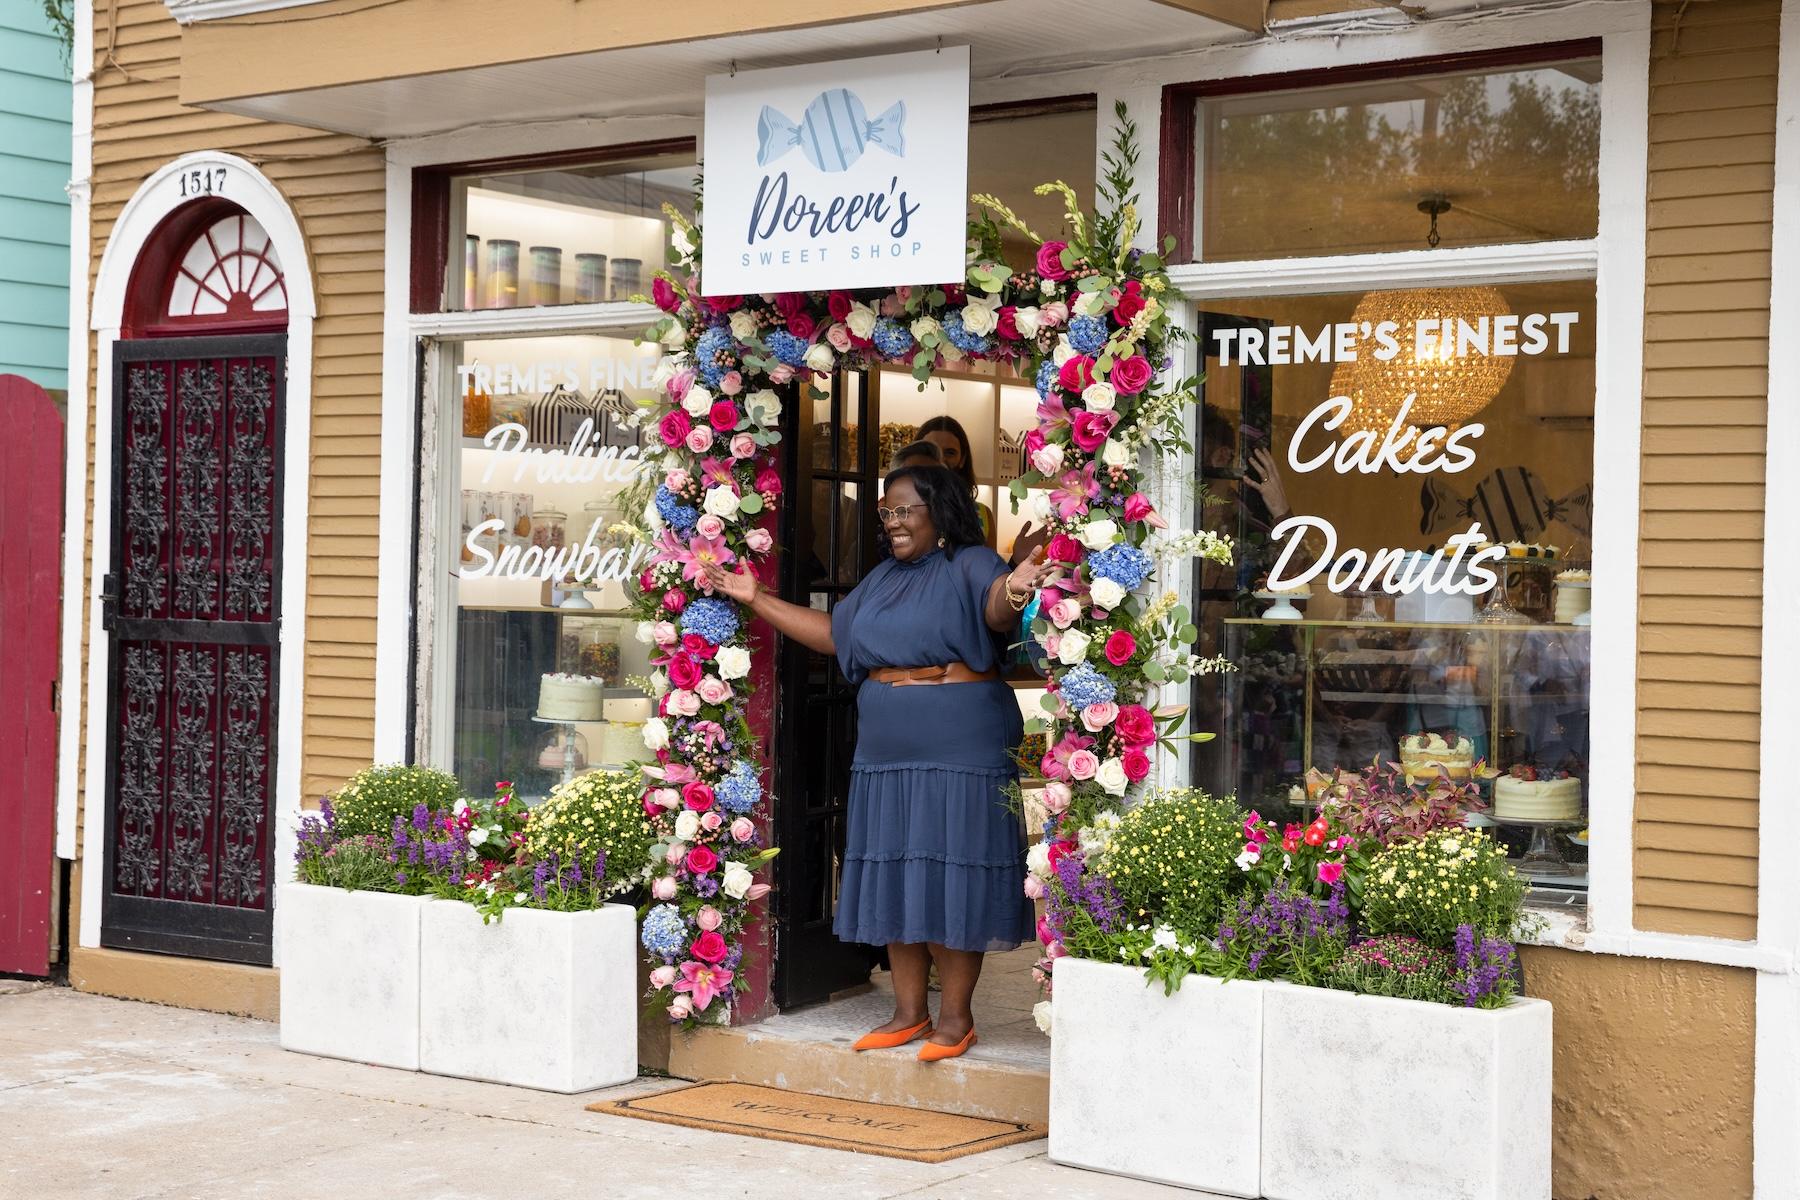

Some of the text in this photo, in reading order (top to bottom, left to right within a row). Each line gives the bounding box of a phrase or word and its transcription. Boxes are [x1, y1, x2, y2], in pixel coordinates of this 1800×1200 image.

[179, 168, 227, 197] 1517
[747, 171, 921, 246] Doreen's
[741, 241, 922, 267] SWEET SHOP
[1212, 311, 1580, 367] TREME'S FINEST
[457, 355, 658, 397] TREME'S FINE
[1287, 392, 1485, 475] Cakes
[458, 516, 659, 583] Snowbal
[1266, 515, 1506, 596] Donuts
[732, 1100, 919, 1132] WELCOME
